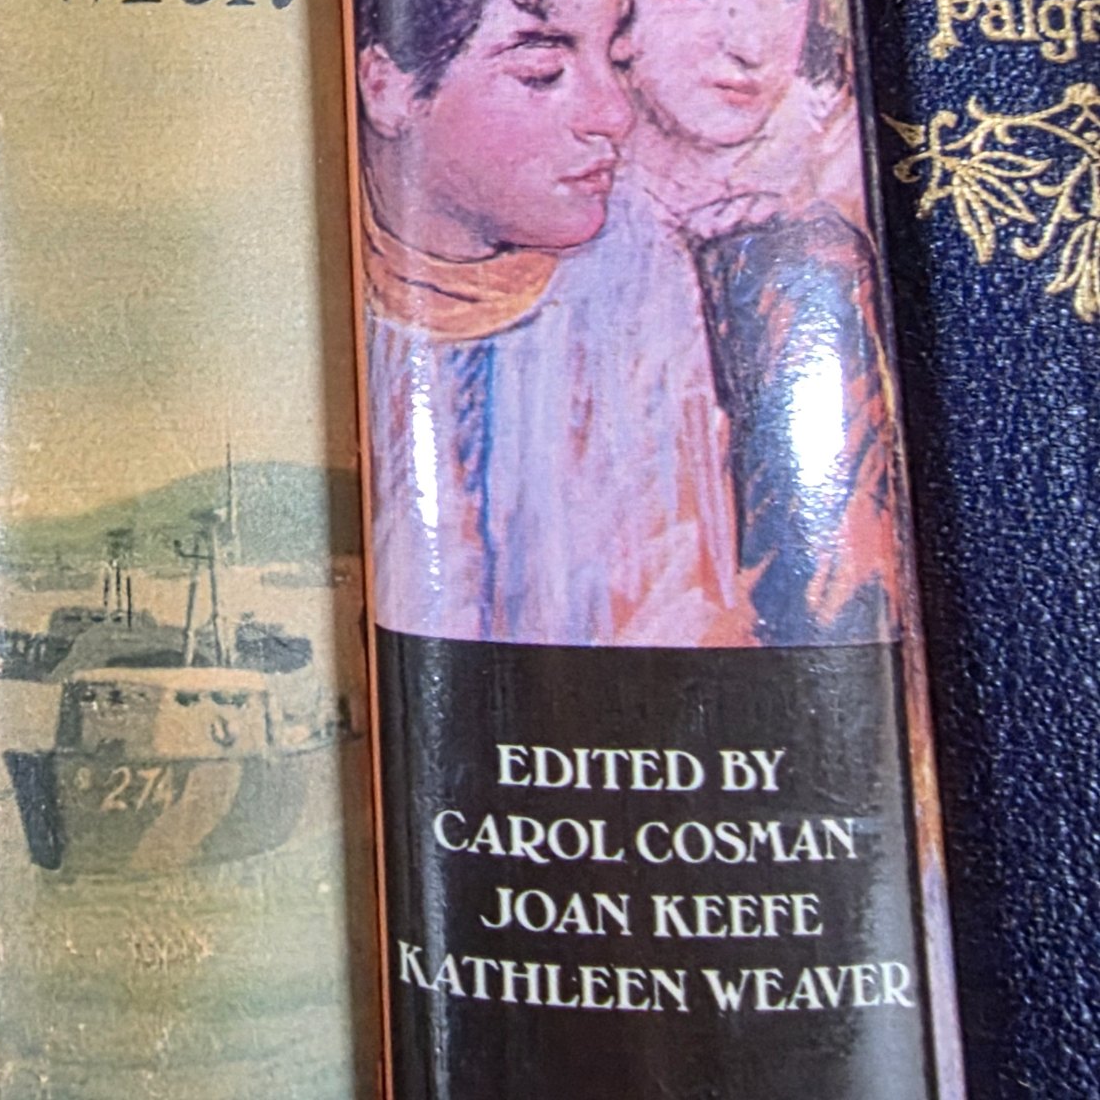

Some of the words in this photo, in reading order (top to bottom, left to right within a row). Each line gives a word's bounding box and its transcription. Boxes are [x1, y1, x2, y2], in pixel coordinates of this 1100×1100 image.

[495, 744, 704, 793] EDITED
[719, 748, 787, 793] BY
[432, 809, 627, 864] CAROL
[635, 817, 858, 864] COSMAN
[479, 887, 631, 937] JOAN
[652, 892, 824, 939] KEEFE
[398, 939, 690, 1013] KATHLEEN
[701, 961, 916, 1012] WEAVER
